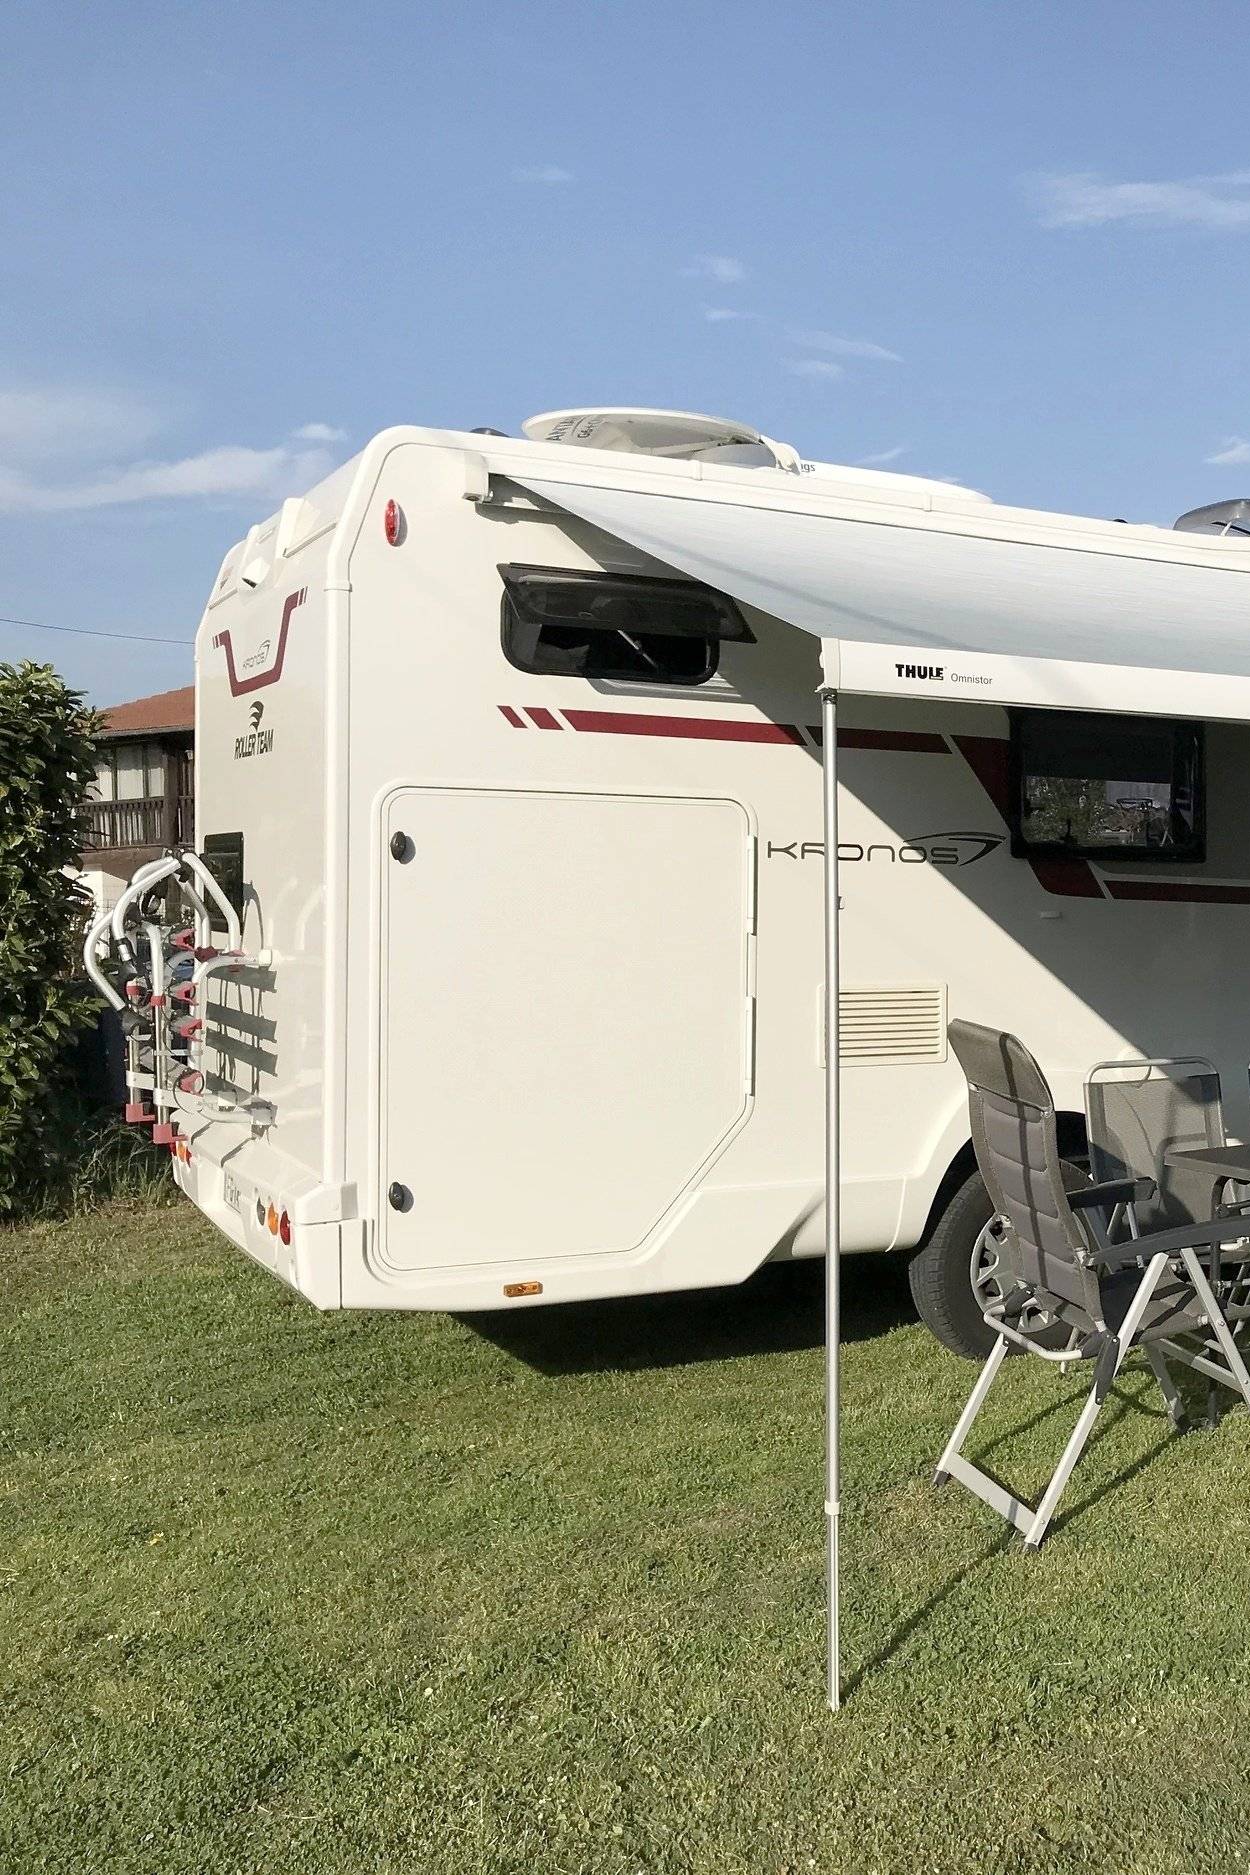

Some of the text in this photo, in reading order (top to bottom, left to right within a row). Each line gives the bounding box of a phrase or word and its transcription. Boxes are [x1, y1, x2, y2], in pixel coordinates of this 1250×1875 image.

[895, 664, 993, 685] THULE Omnistor
[234, 729, 274, 760] ROLLER TEAM
